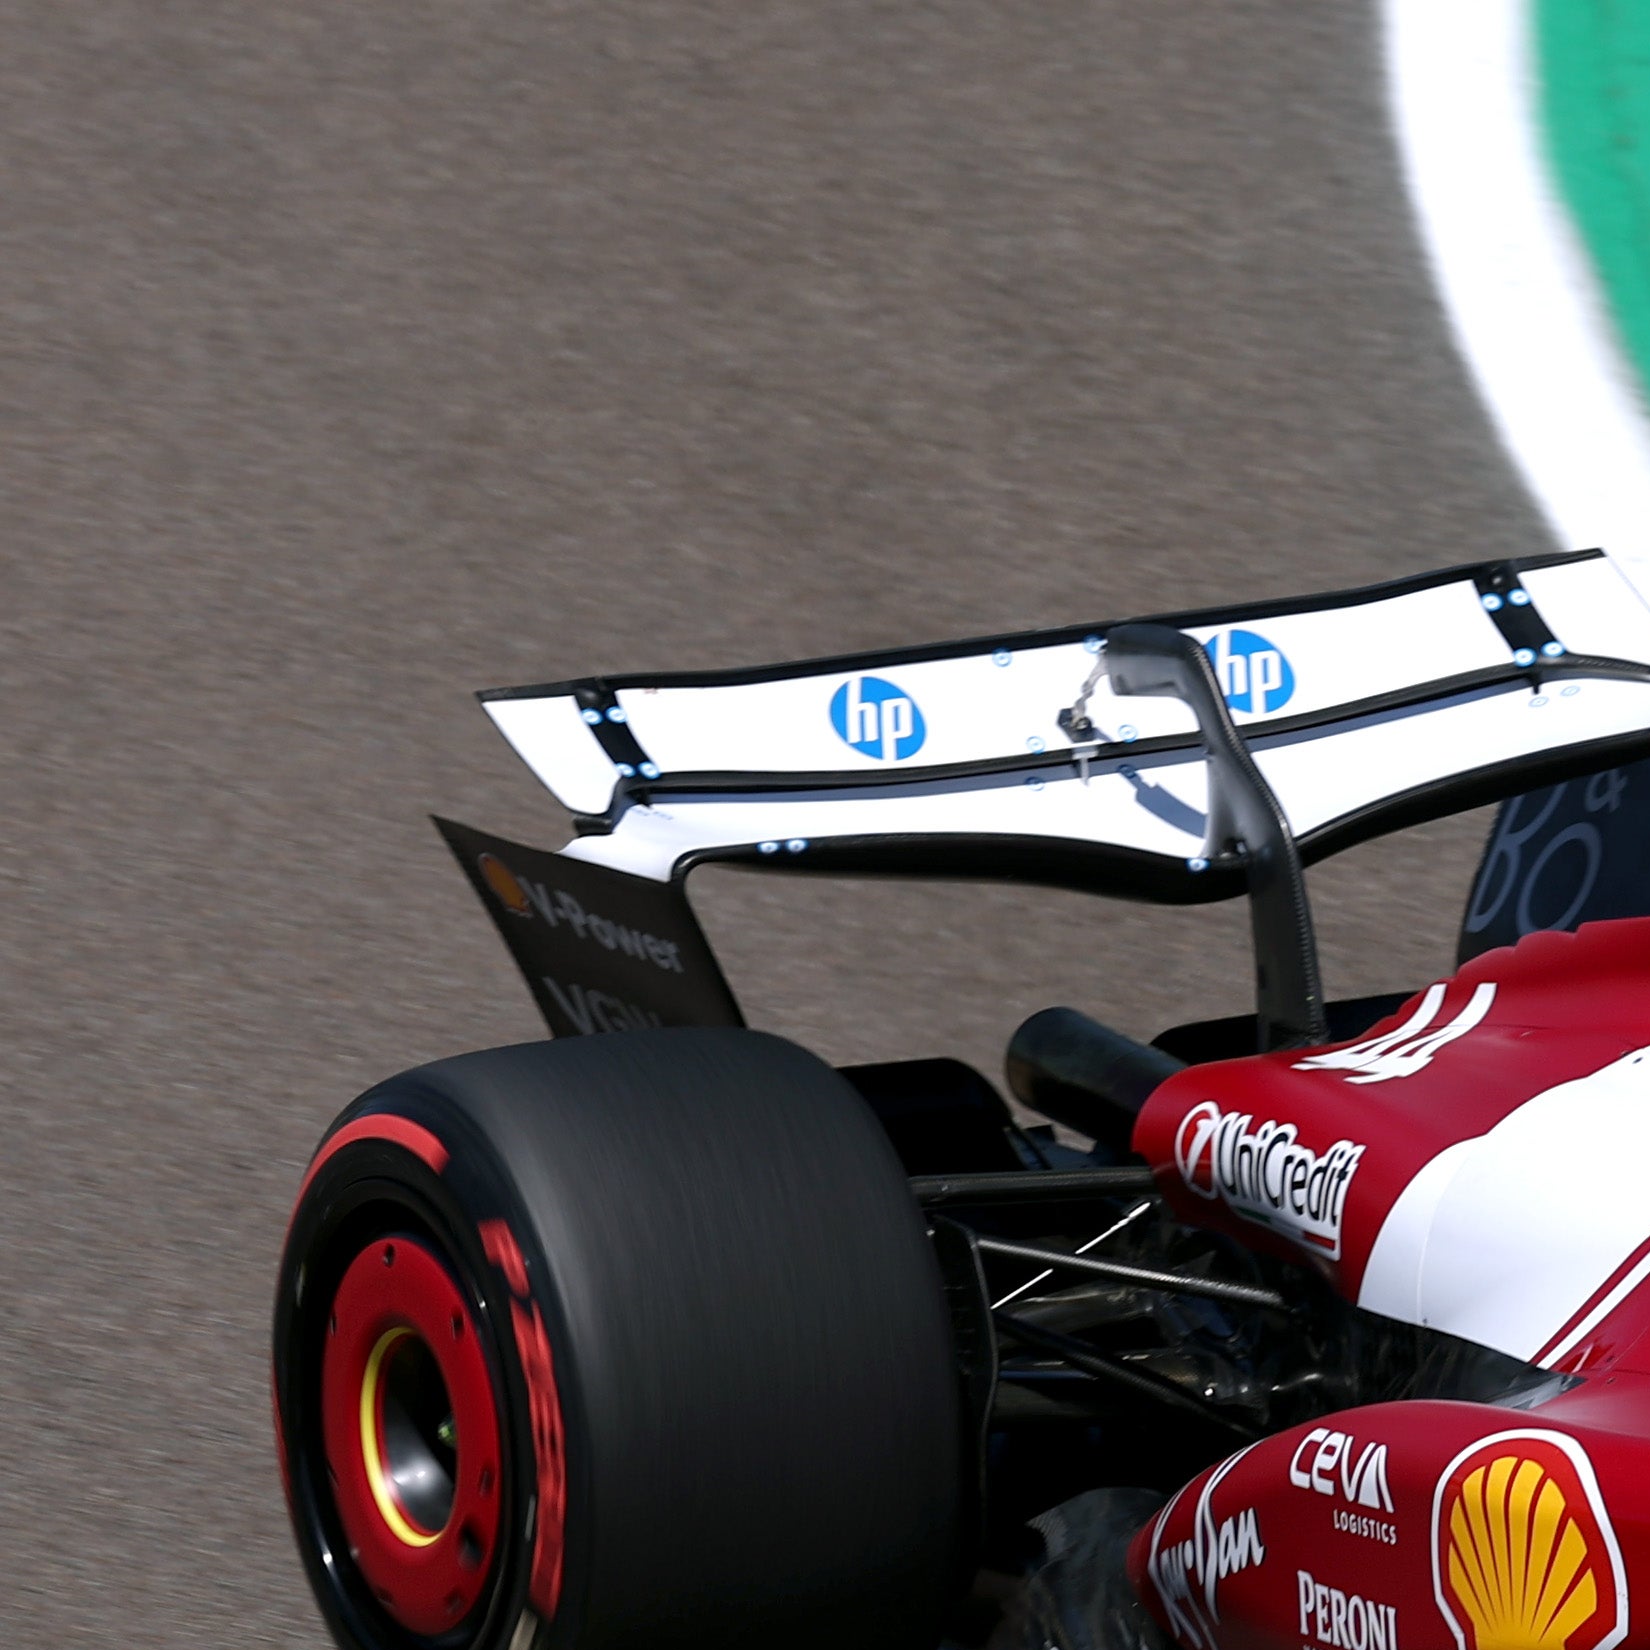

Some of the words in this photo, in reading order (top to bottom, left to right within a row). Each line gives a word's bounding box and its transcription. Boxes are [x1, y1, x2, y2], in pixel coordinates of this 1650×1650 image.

[1210, 630, 1288, 713] hp
[838, 676, 920, 760] hp
[517, 875, 684, 973] V-Power
[1292, 983, 1498, 1085] 44
[1214, 1110, 1365, 1228] UniCredit
[1333, 1509, 1397, 1545] LOGISTICS
